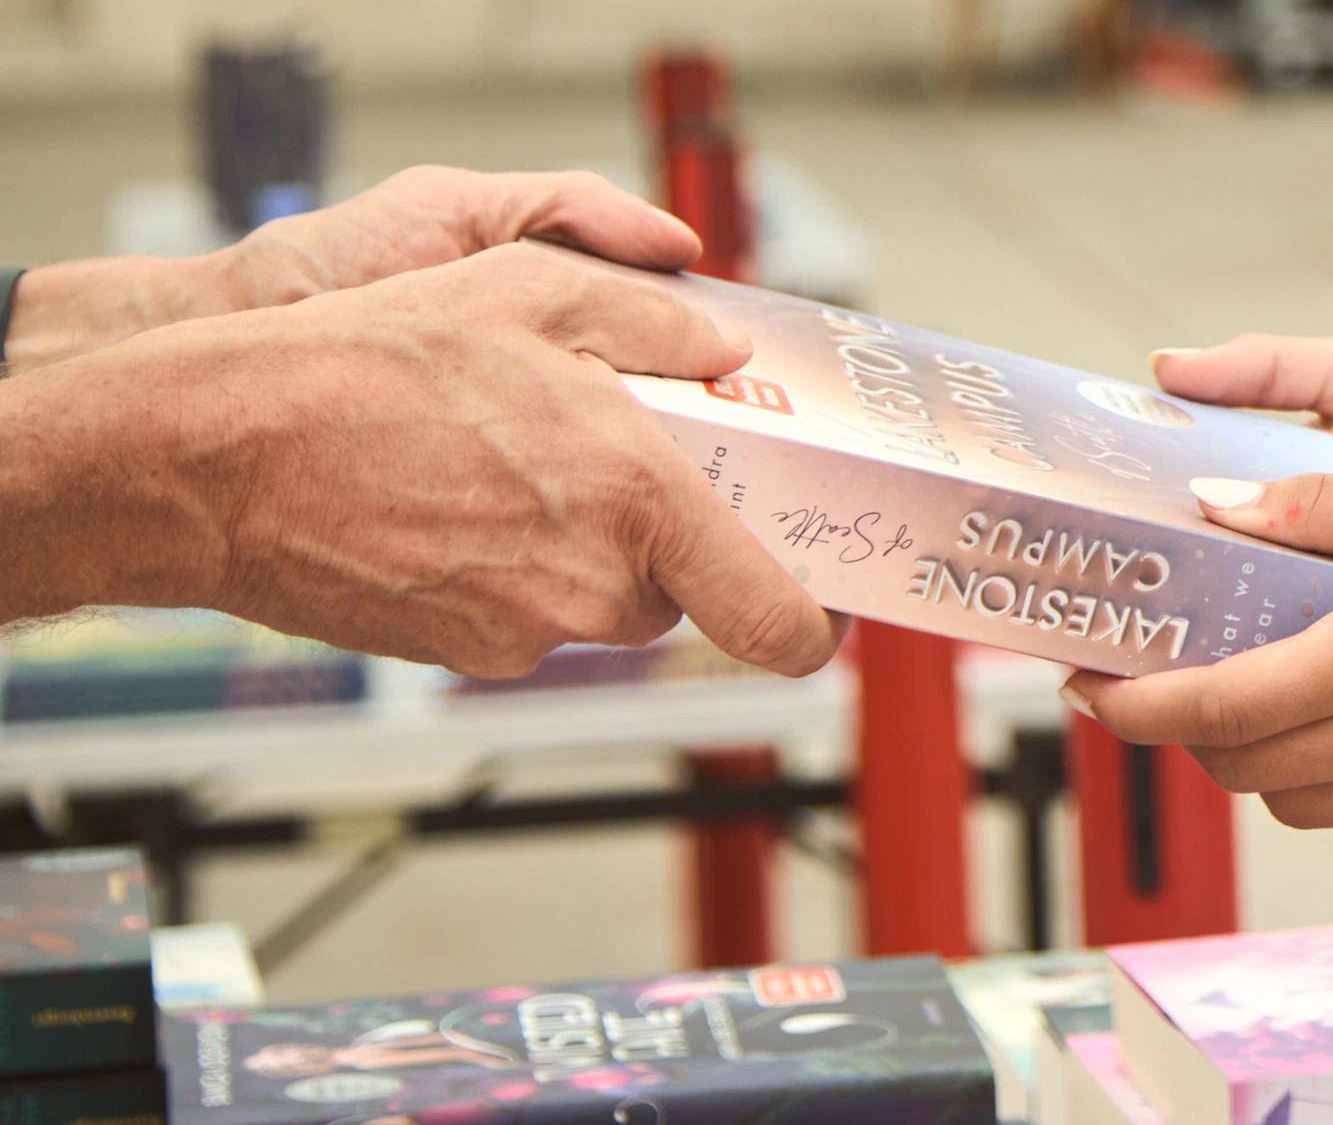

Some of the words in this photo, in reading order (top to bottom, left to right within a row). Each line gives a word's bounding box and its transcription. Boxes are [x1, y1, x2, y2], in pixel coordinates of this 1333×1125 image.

[820, 307, 961, 466] LAKESTONE
[933, 351, 1055, 472] CAMPUS
[701, 445, 728, 485] dra
[729, 482, 748, 510] int
[770, 504, 882, 564] Seattle
[882, 523, 914, 558] of
[955, 511, 1171, 594] CAMPUS
[906, 557, 1190, 660] LAKESTONE
[1211, 611, 1242, 659] hat
[1233, 561, 1256, 599] we
[1250, 597, 1278, 647] ear
